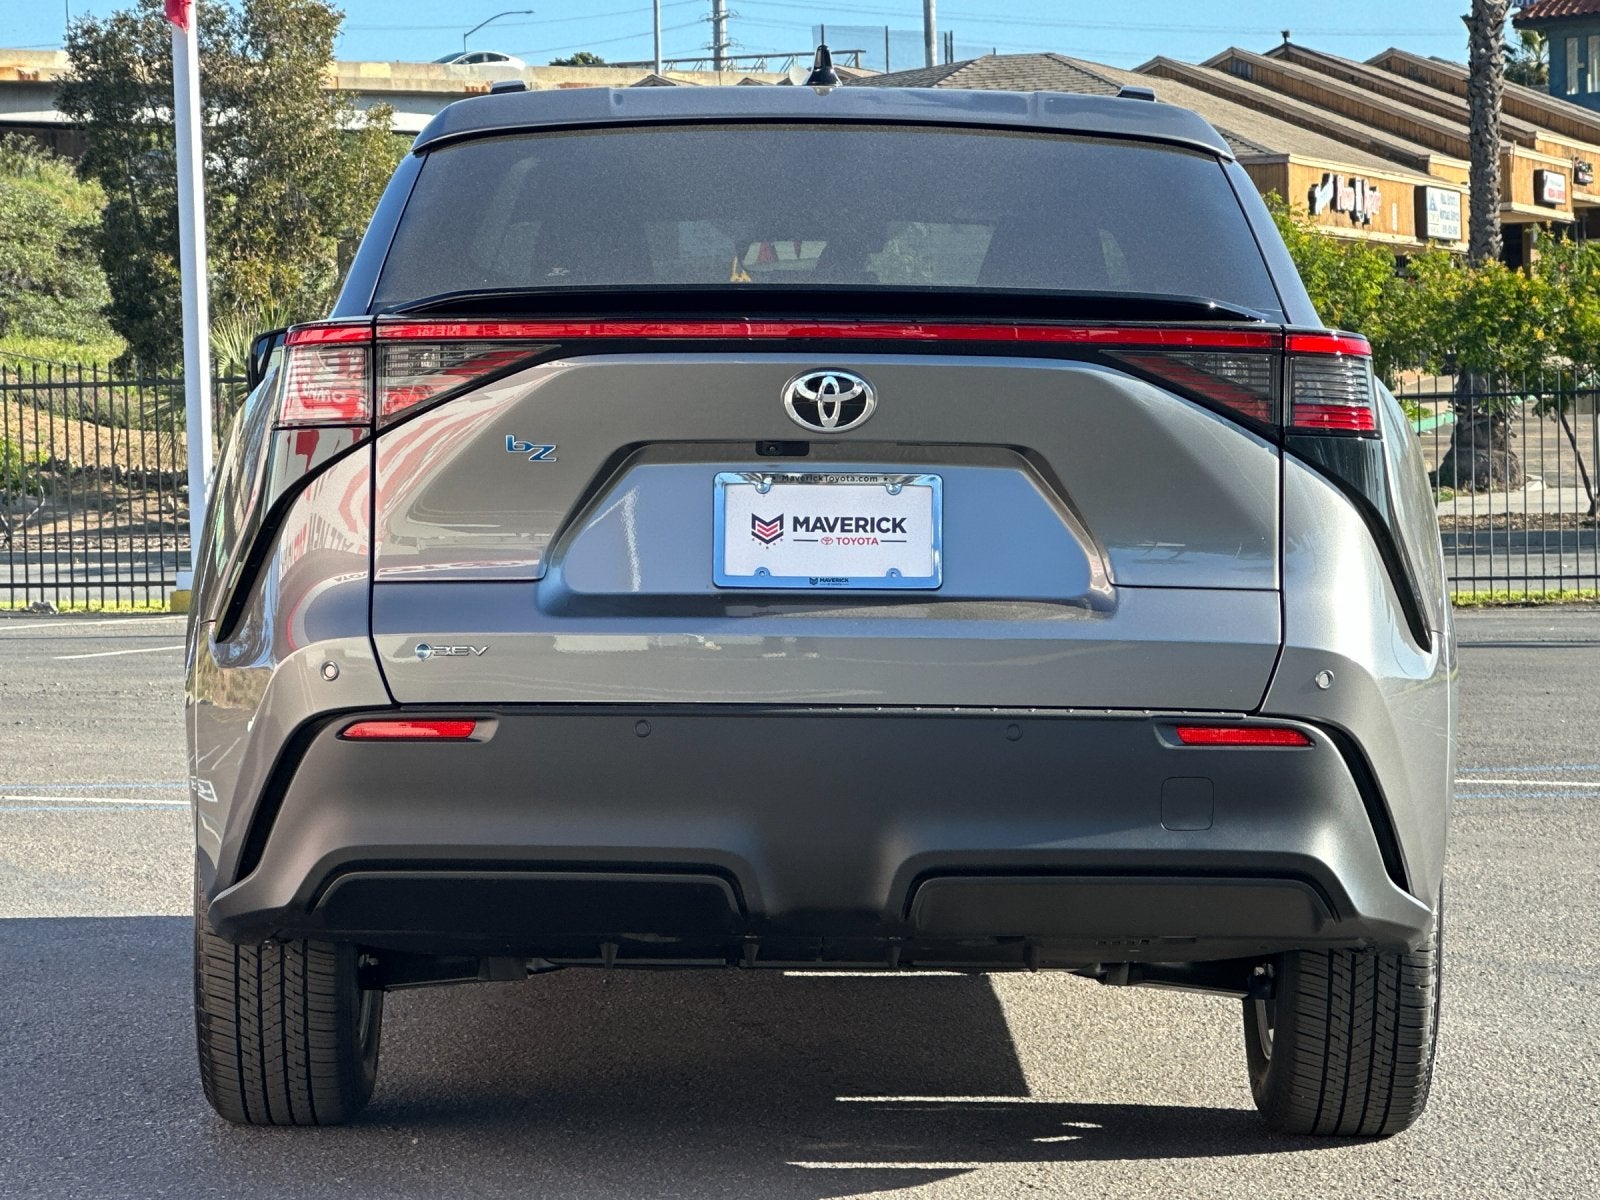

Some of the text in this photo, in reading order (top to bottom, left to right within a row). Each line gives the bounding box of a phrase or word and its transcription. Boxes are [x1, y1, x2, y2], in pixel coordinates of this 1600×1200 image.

[781, 474, 879, 483] MaverickToyota.com
[792, 516, 907, 534] MAVERICK
[836, 537, 880, 546] TOYOTA
